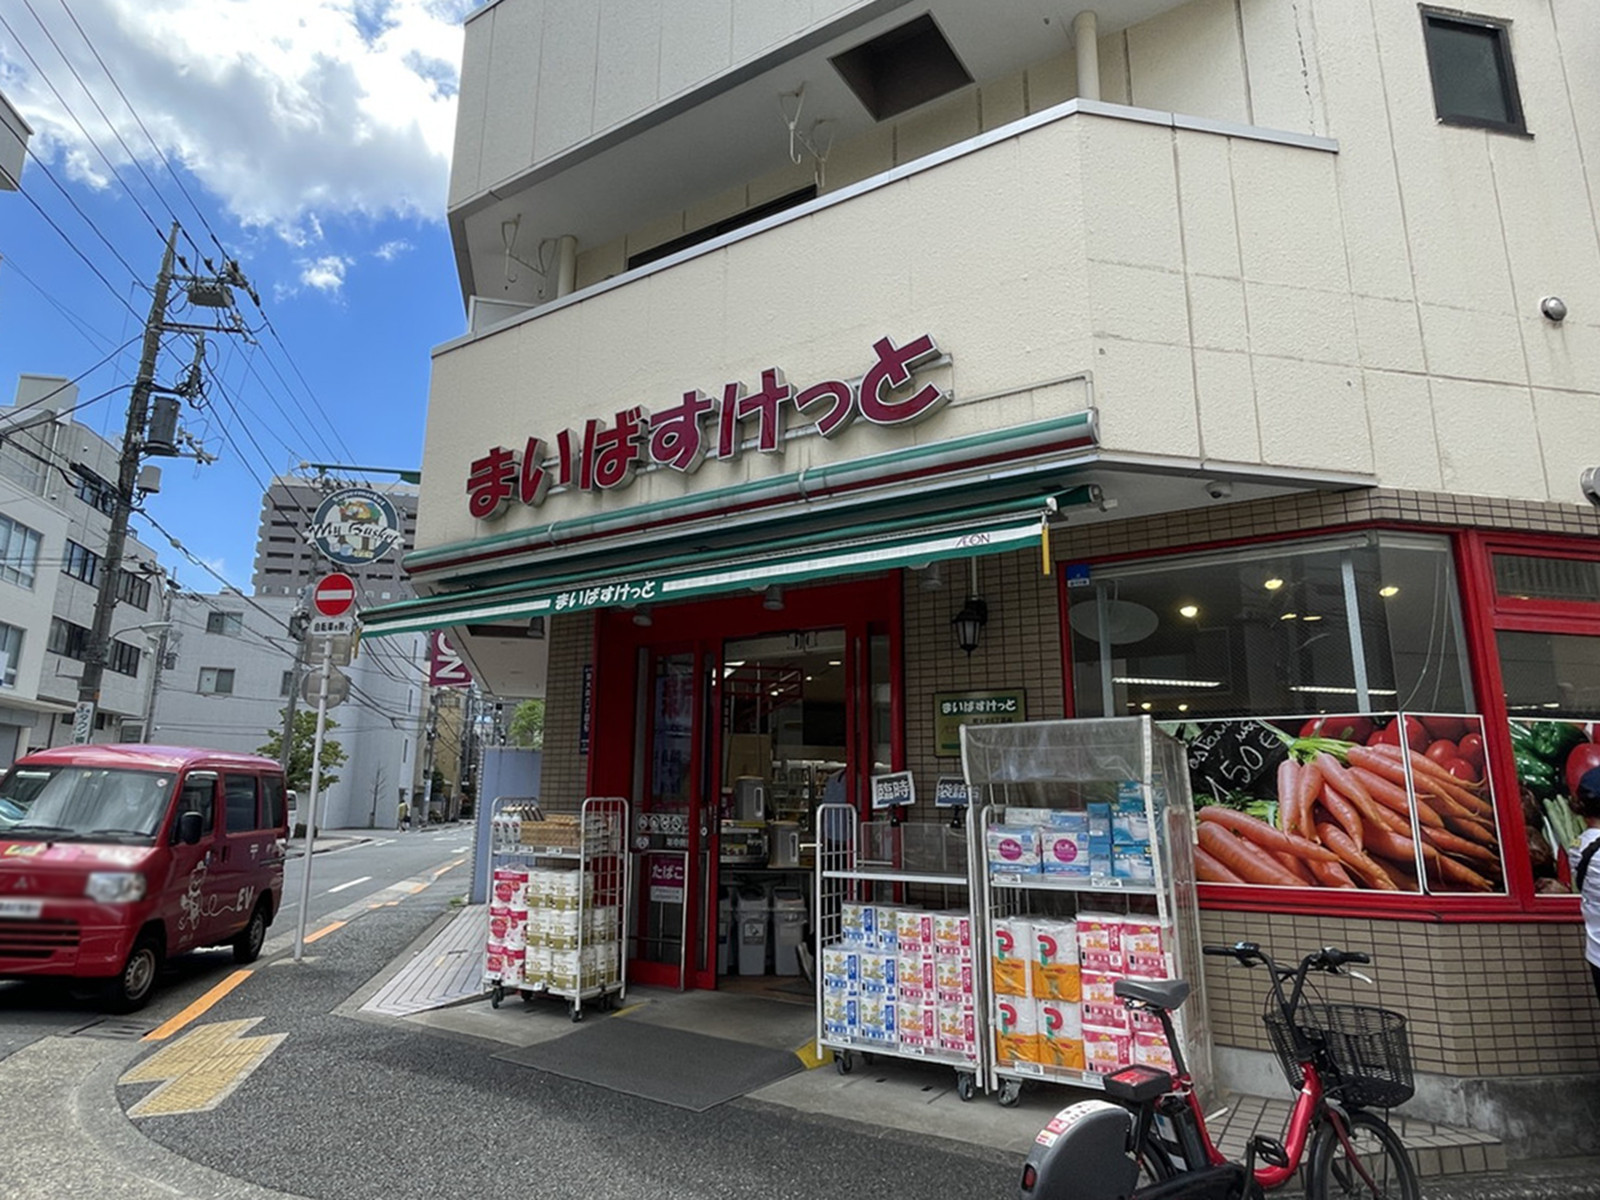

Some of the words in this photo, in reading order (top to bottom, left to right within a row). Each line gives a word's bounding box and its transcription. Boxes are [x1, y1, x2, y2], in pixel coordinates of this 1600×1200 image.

[466, 333, 945, 519] まいばすけっと
[308, 521, 341, 539] My
[554, 580, 656, 610] まいばすけっと
[941, 699, 1017, 714] まいばすけっと
[651, 864, 684, 880] たばこ
[236, 885, 255, 912] EV
